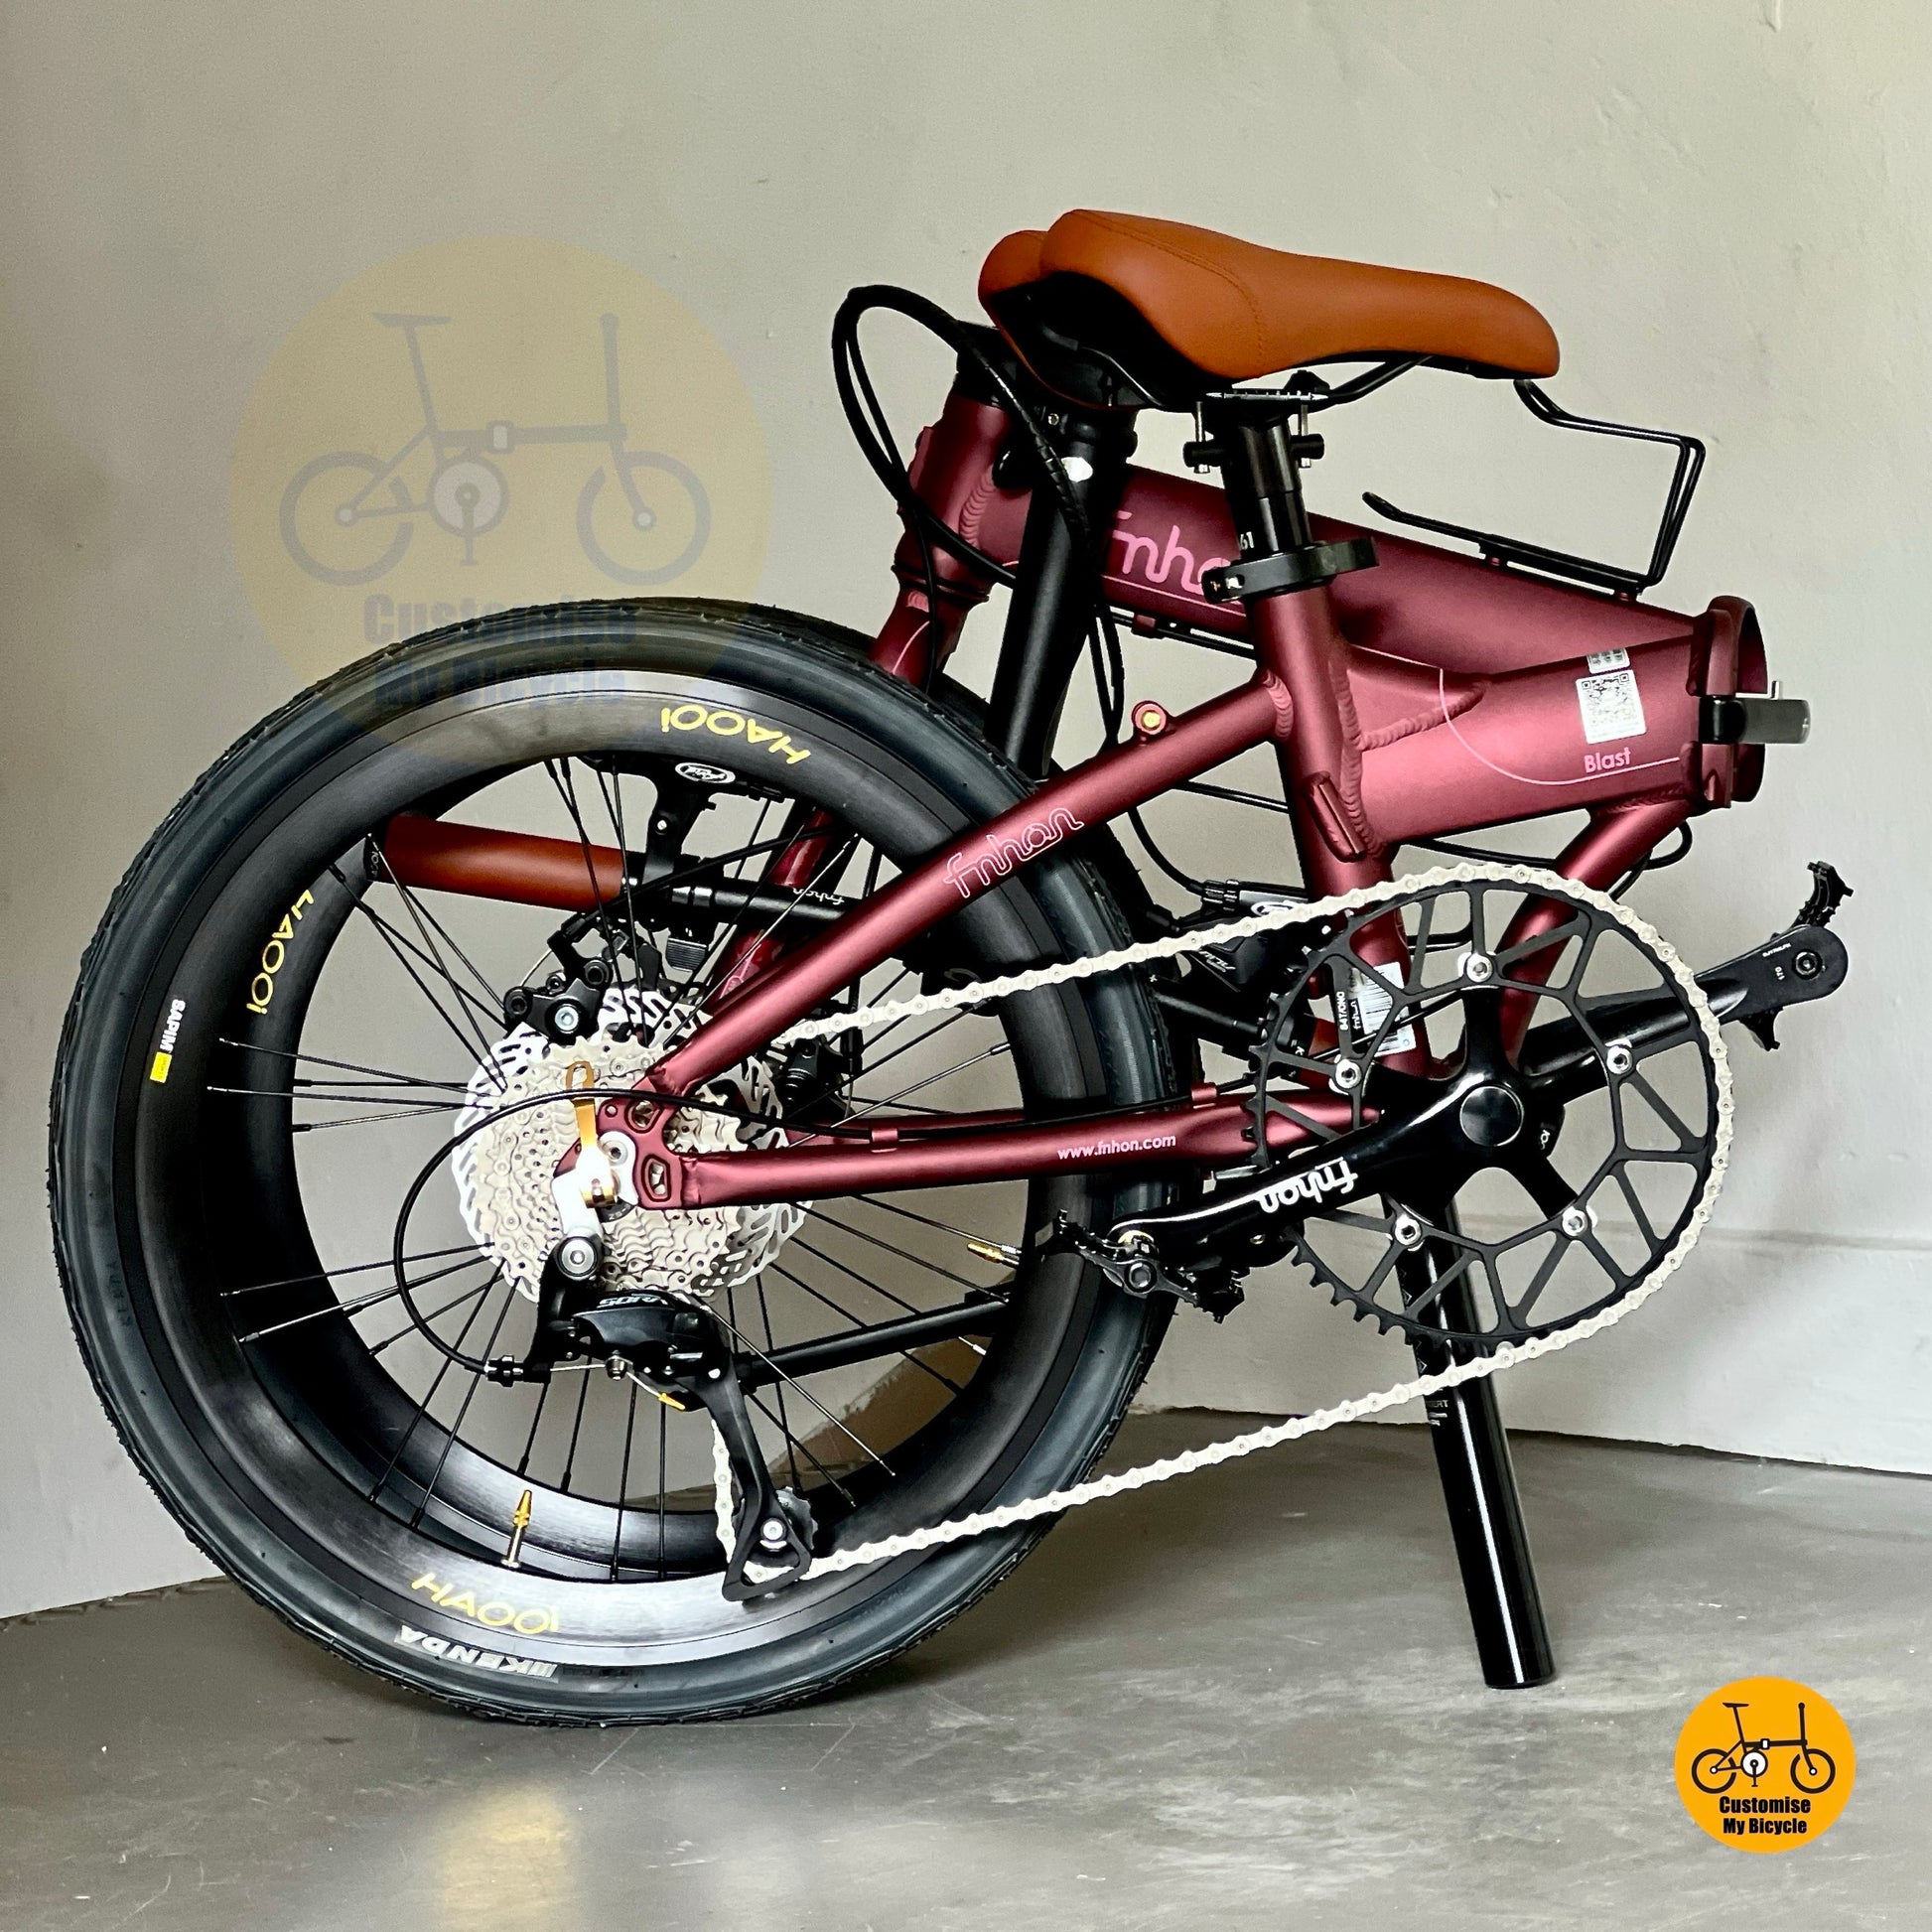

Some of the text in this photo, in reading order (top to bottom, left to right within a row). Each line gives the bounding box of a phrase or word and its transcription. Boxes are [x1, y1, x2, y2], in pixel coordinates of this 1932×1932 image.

[1584, 747, 1631, 772] Blast
[944, 807, 1084, 898] fnhon
[159, 999, 186, 1054] SAPIM
[1057, 1134, 1176, 1160] www.fnhon.com
[1255, 1157, 1358, 1213] fnhon
